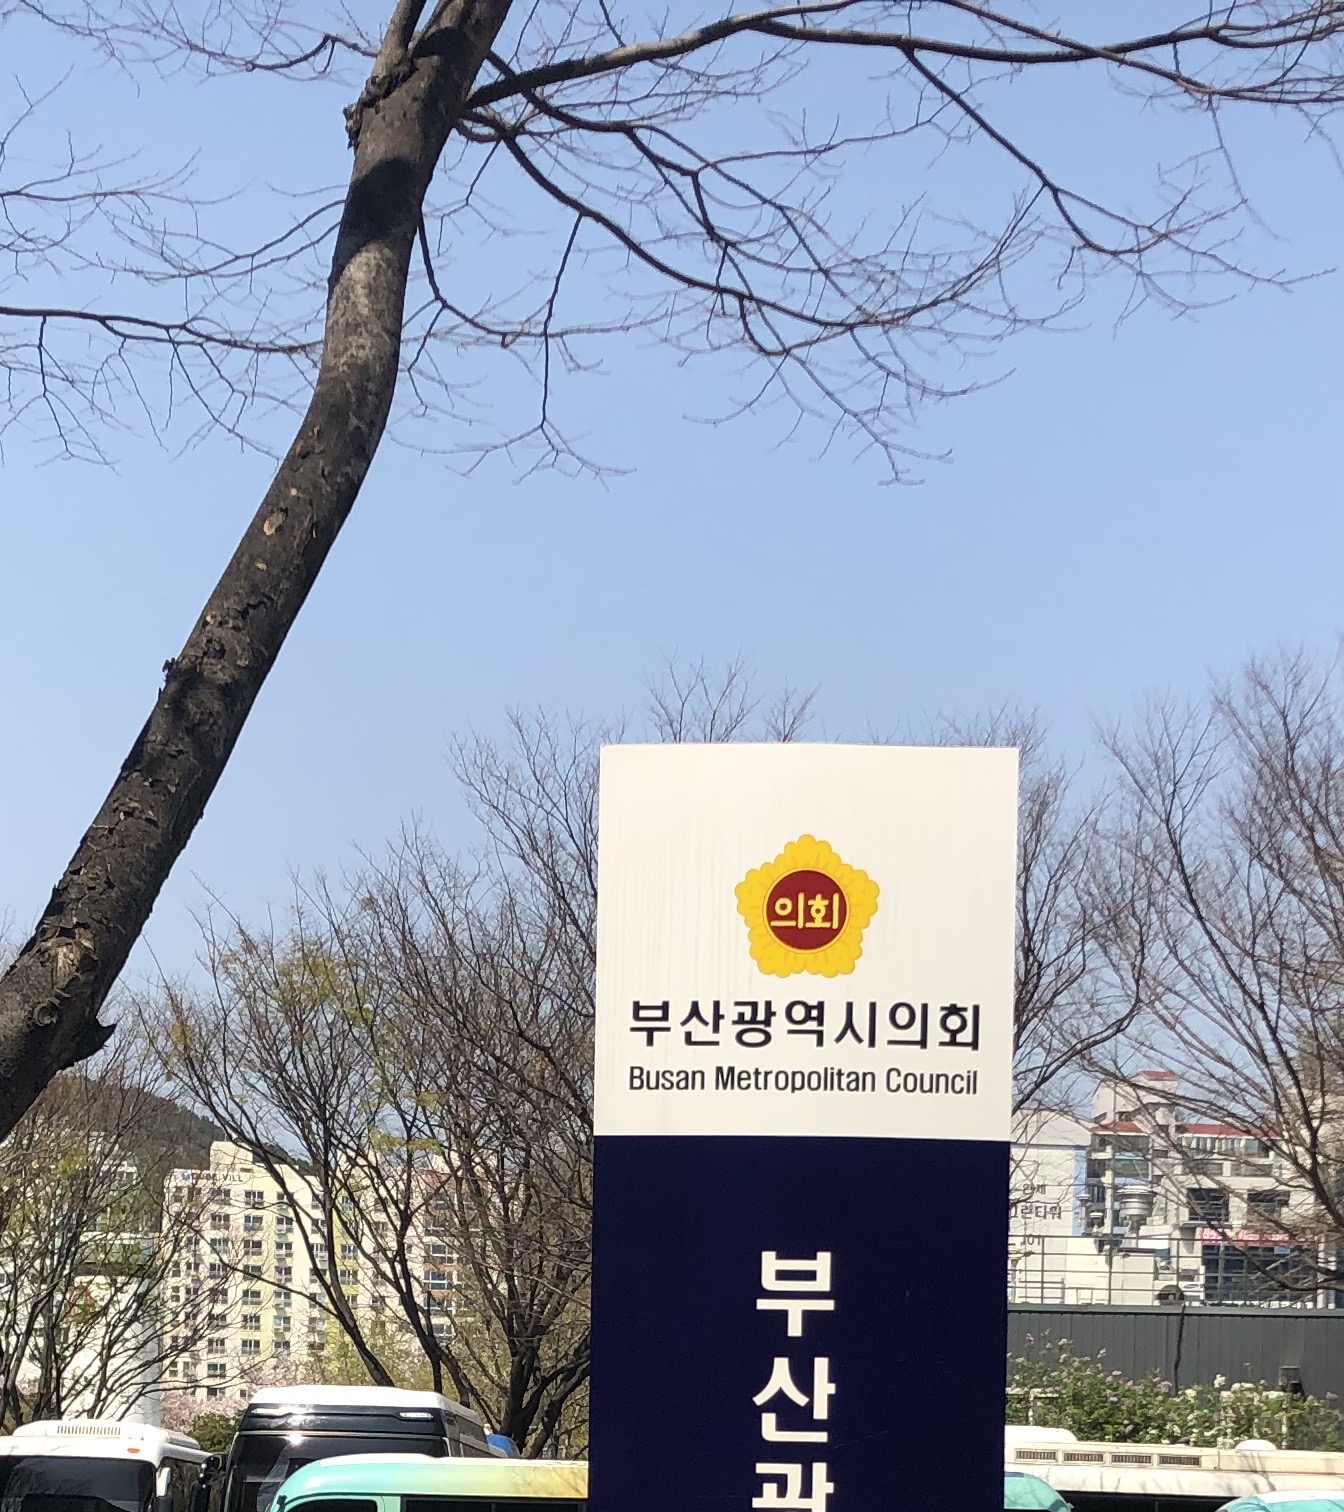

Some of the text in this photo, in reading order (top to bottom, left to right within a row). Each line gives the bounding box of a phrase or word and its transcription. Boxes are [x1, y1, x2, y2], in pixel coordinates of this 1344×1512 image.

[770, 892, 839, 930] 의회
[629, 1000, 981, 1051] 부산광역시의회
[629, 1065, 979, 1096] Busan Metropolitan Council
